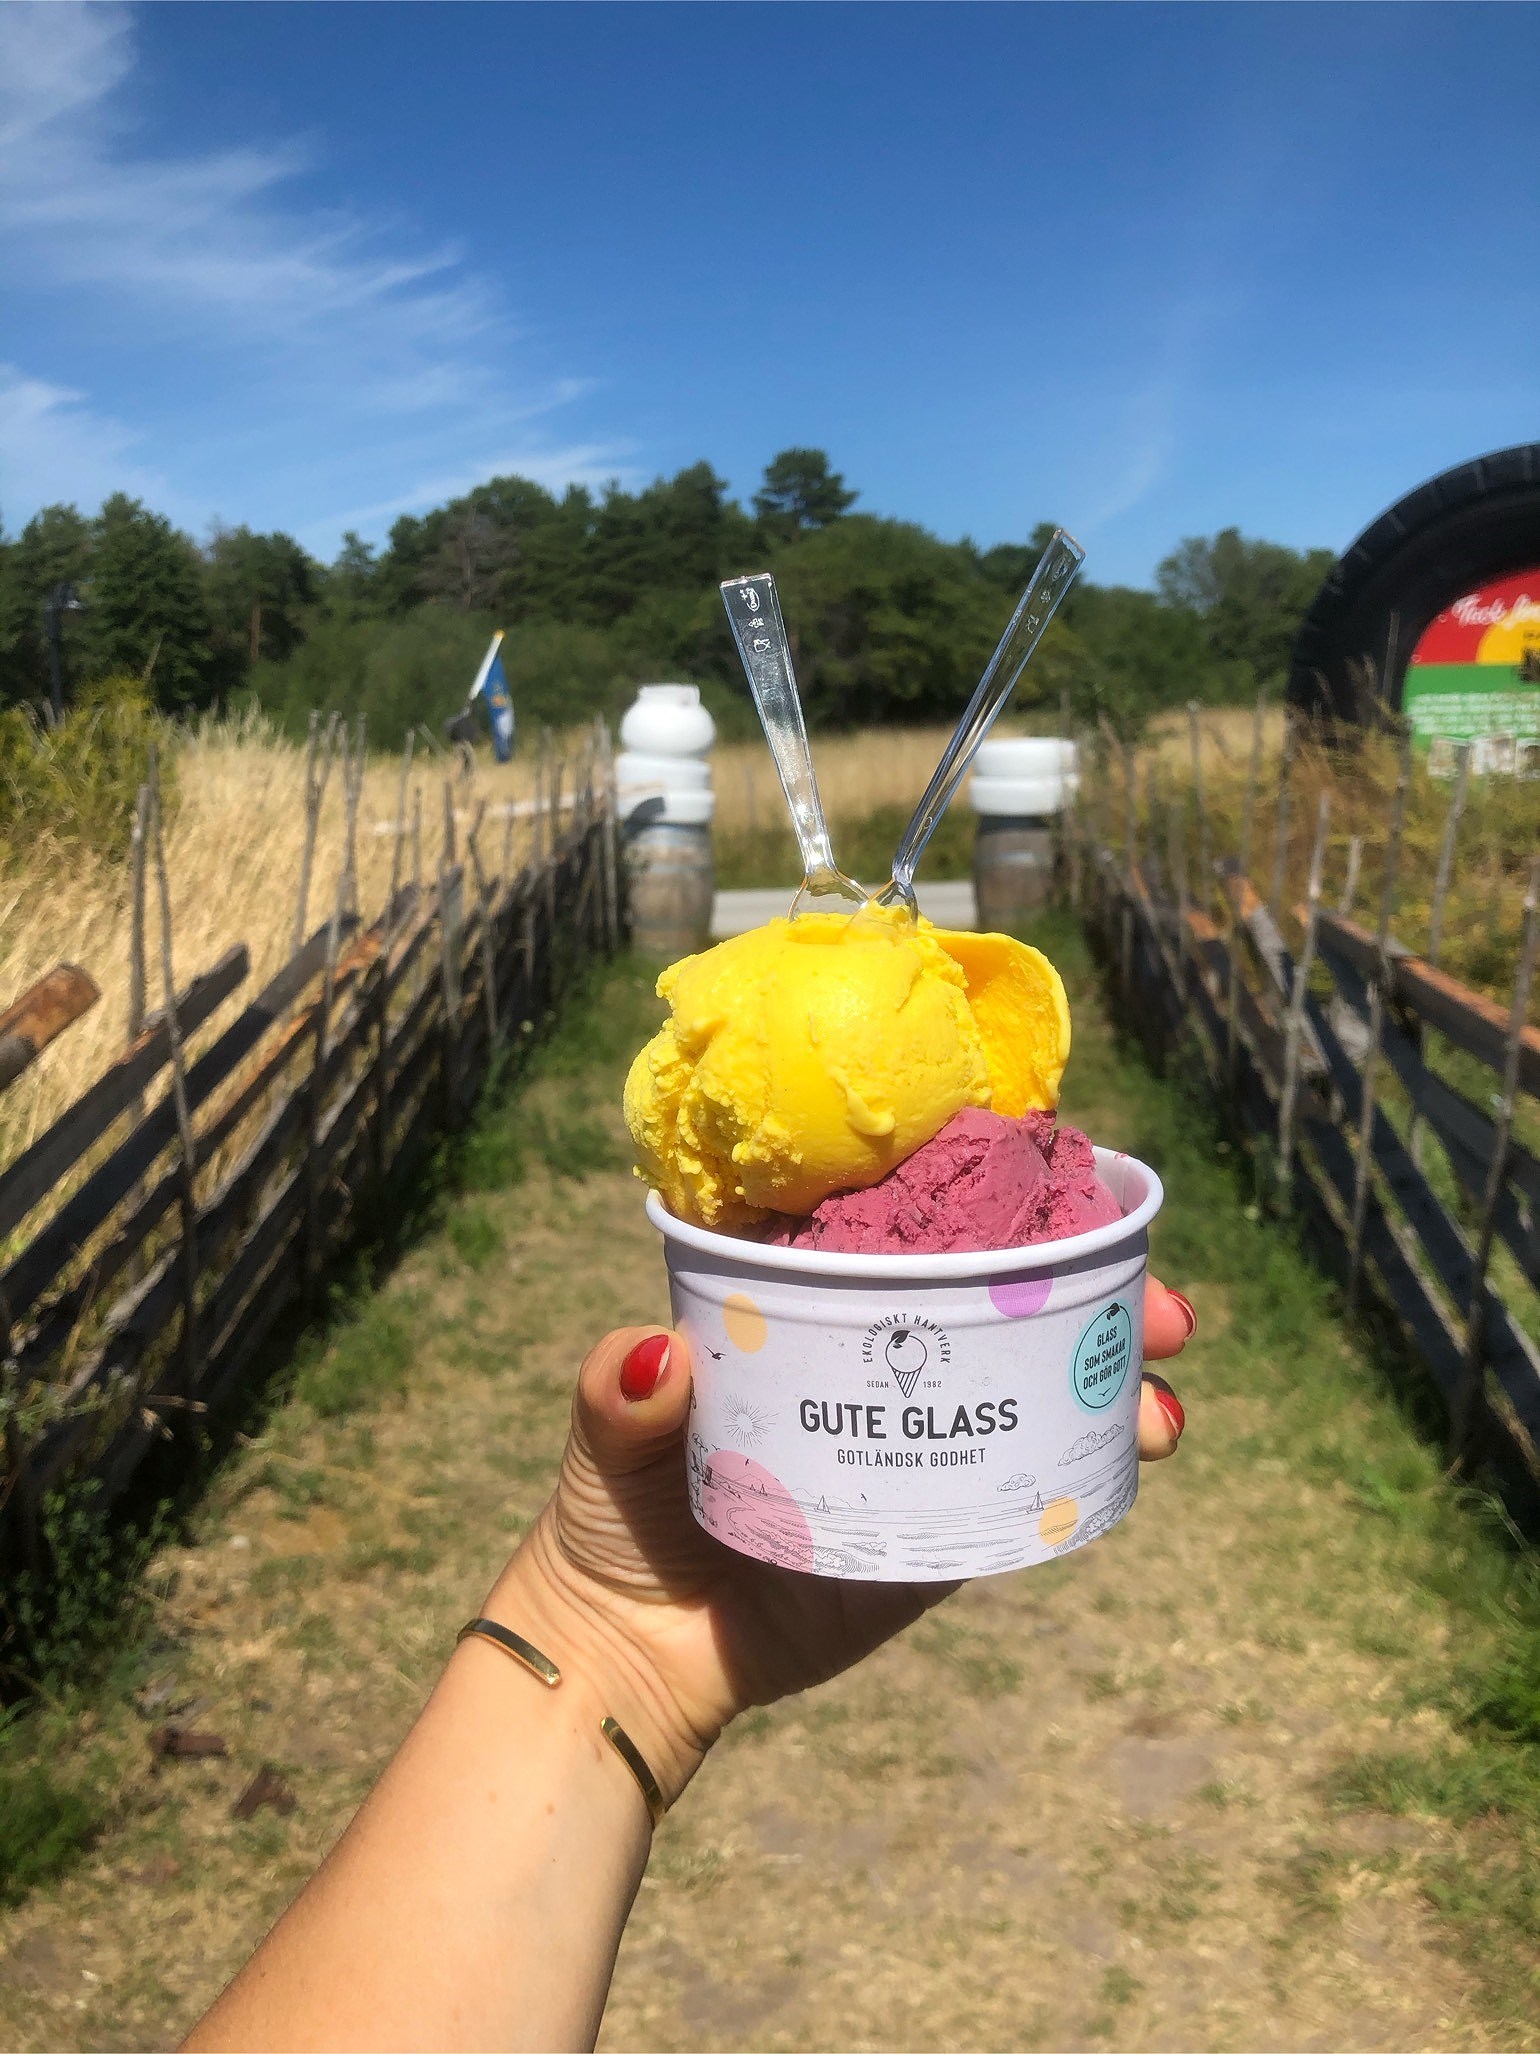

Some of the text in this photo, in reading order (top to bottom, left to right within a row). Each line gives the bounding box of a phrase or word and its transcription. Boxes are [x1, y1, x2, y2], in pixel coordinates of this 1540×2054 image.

[862, 1313, 951, 1363] EKOLOGISKT HANTVERK
[1097, 1326, 1118, 1347] GLASS
[1084, 1338, 1126, 1371] SOM SMAKAR
[866, 1380, 942, 1389] SEDAN 1982
[1083, 1354, 1127, 1390] OCH GÖR GOTT
[800, 1398, 1018, 1439] GUTE GLASS
[837, 1448, 986, 1467] GOTLÄNDSK GODHET
